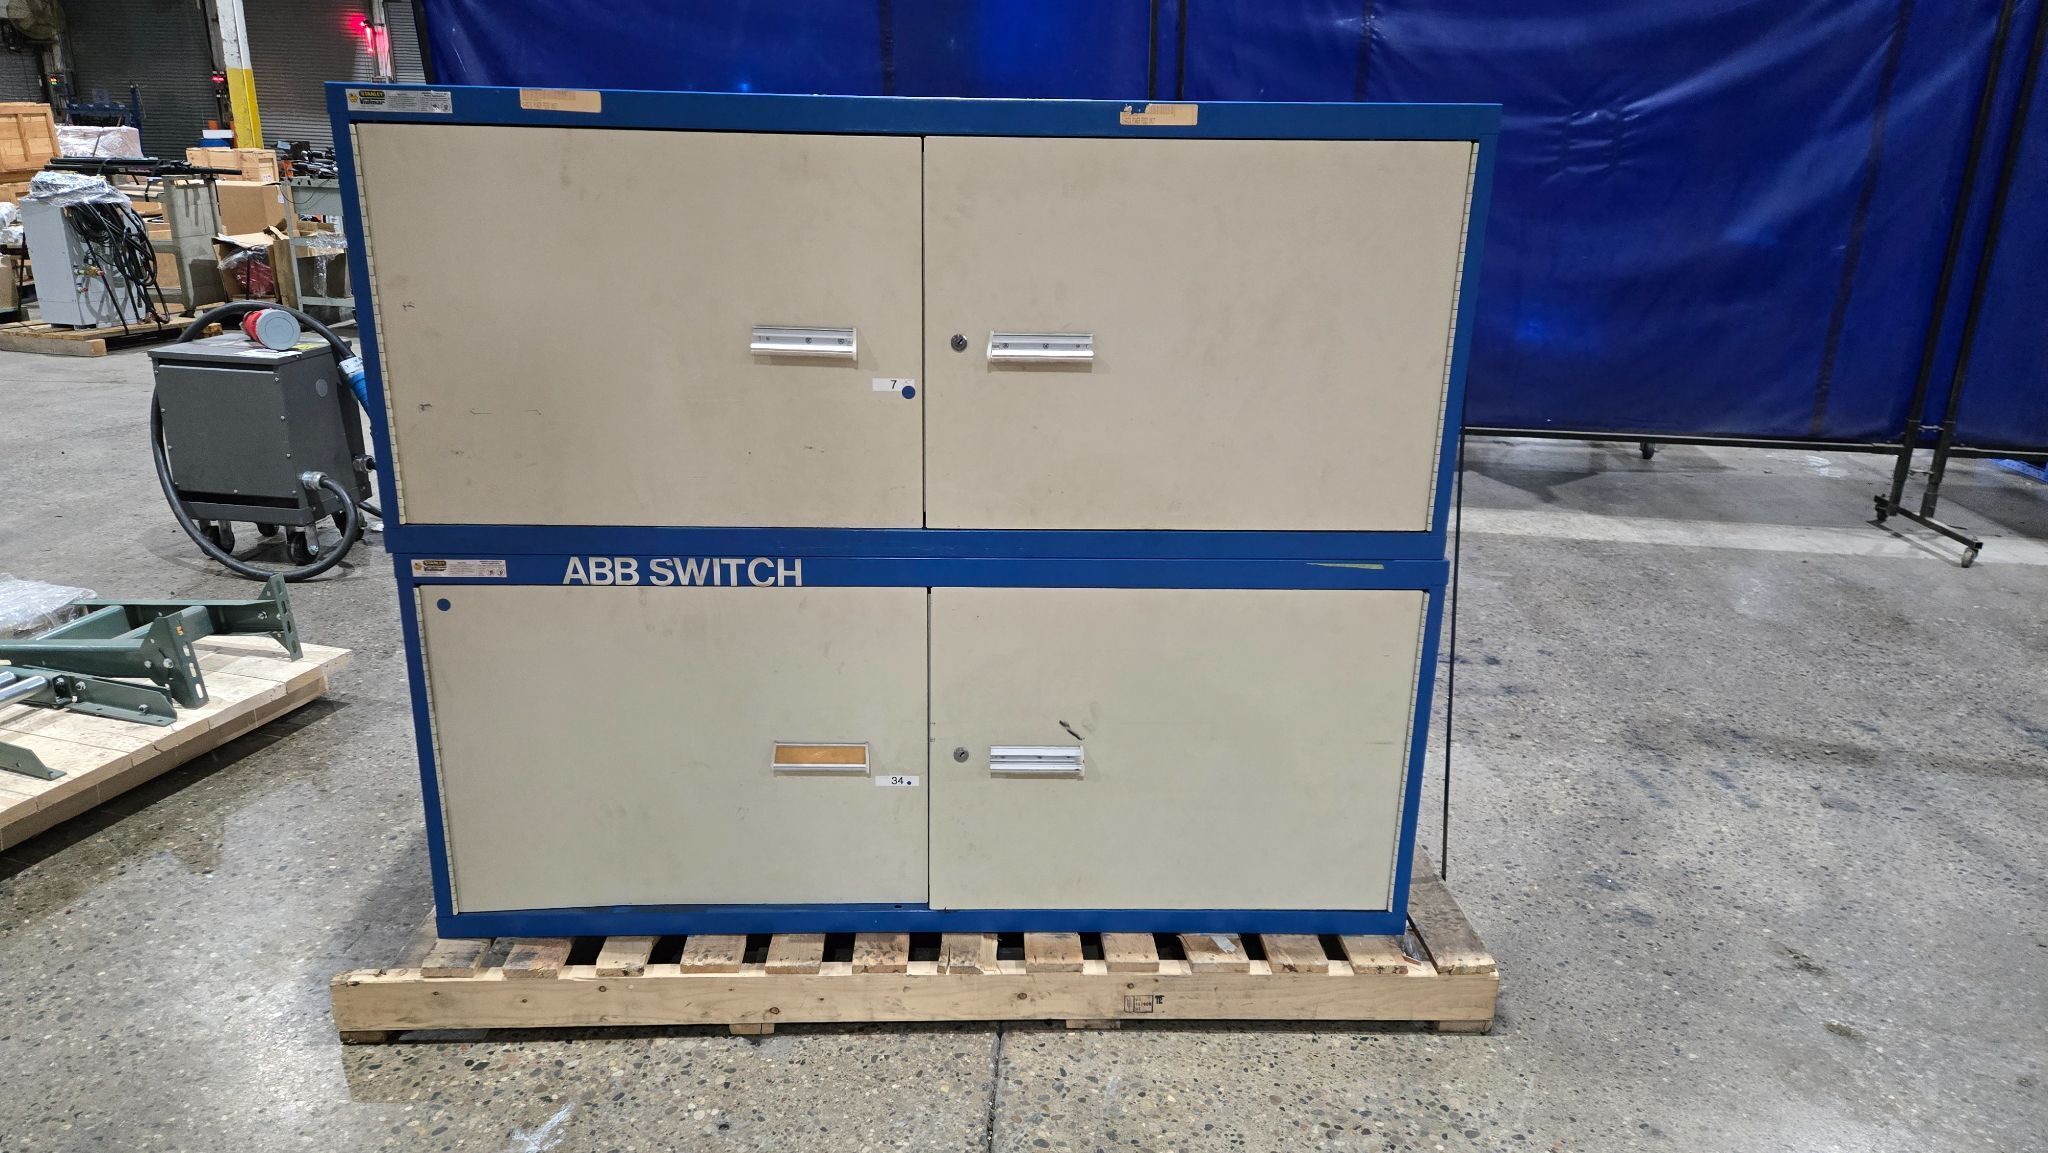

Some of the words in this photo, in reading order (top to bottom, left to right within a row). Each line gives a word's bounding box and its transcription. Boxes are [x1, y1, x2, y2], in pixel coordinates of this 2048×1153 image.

[890, 379, 897, 389] 7
[562, 556, 640, 586] ABB
[649, 556, 803, 587] SWITCH
[891, 776, 903, 785] 34
